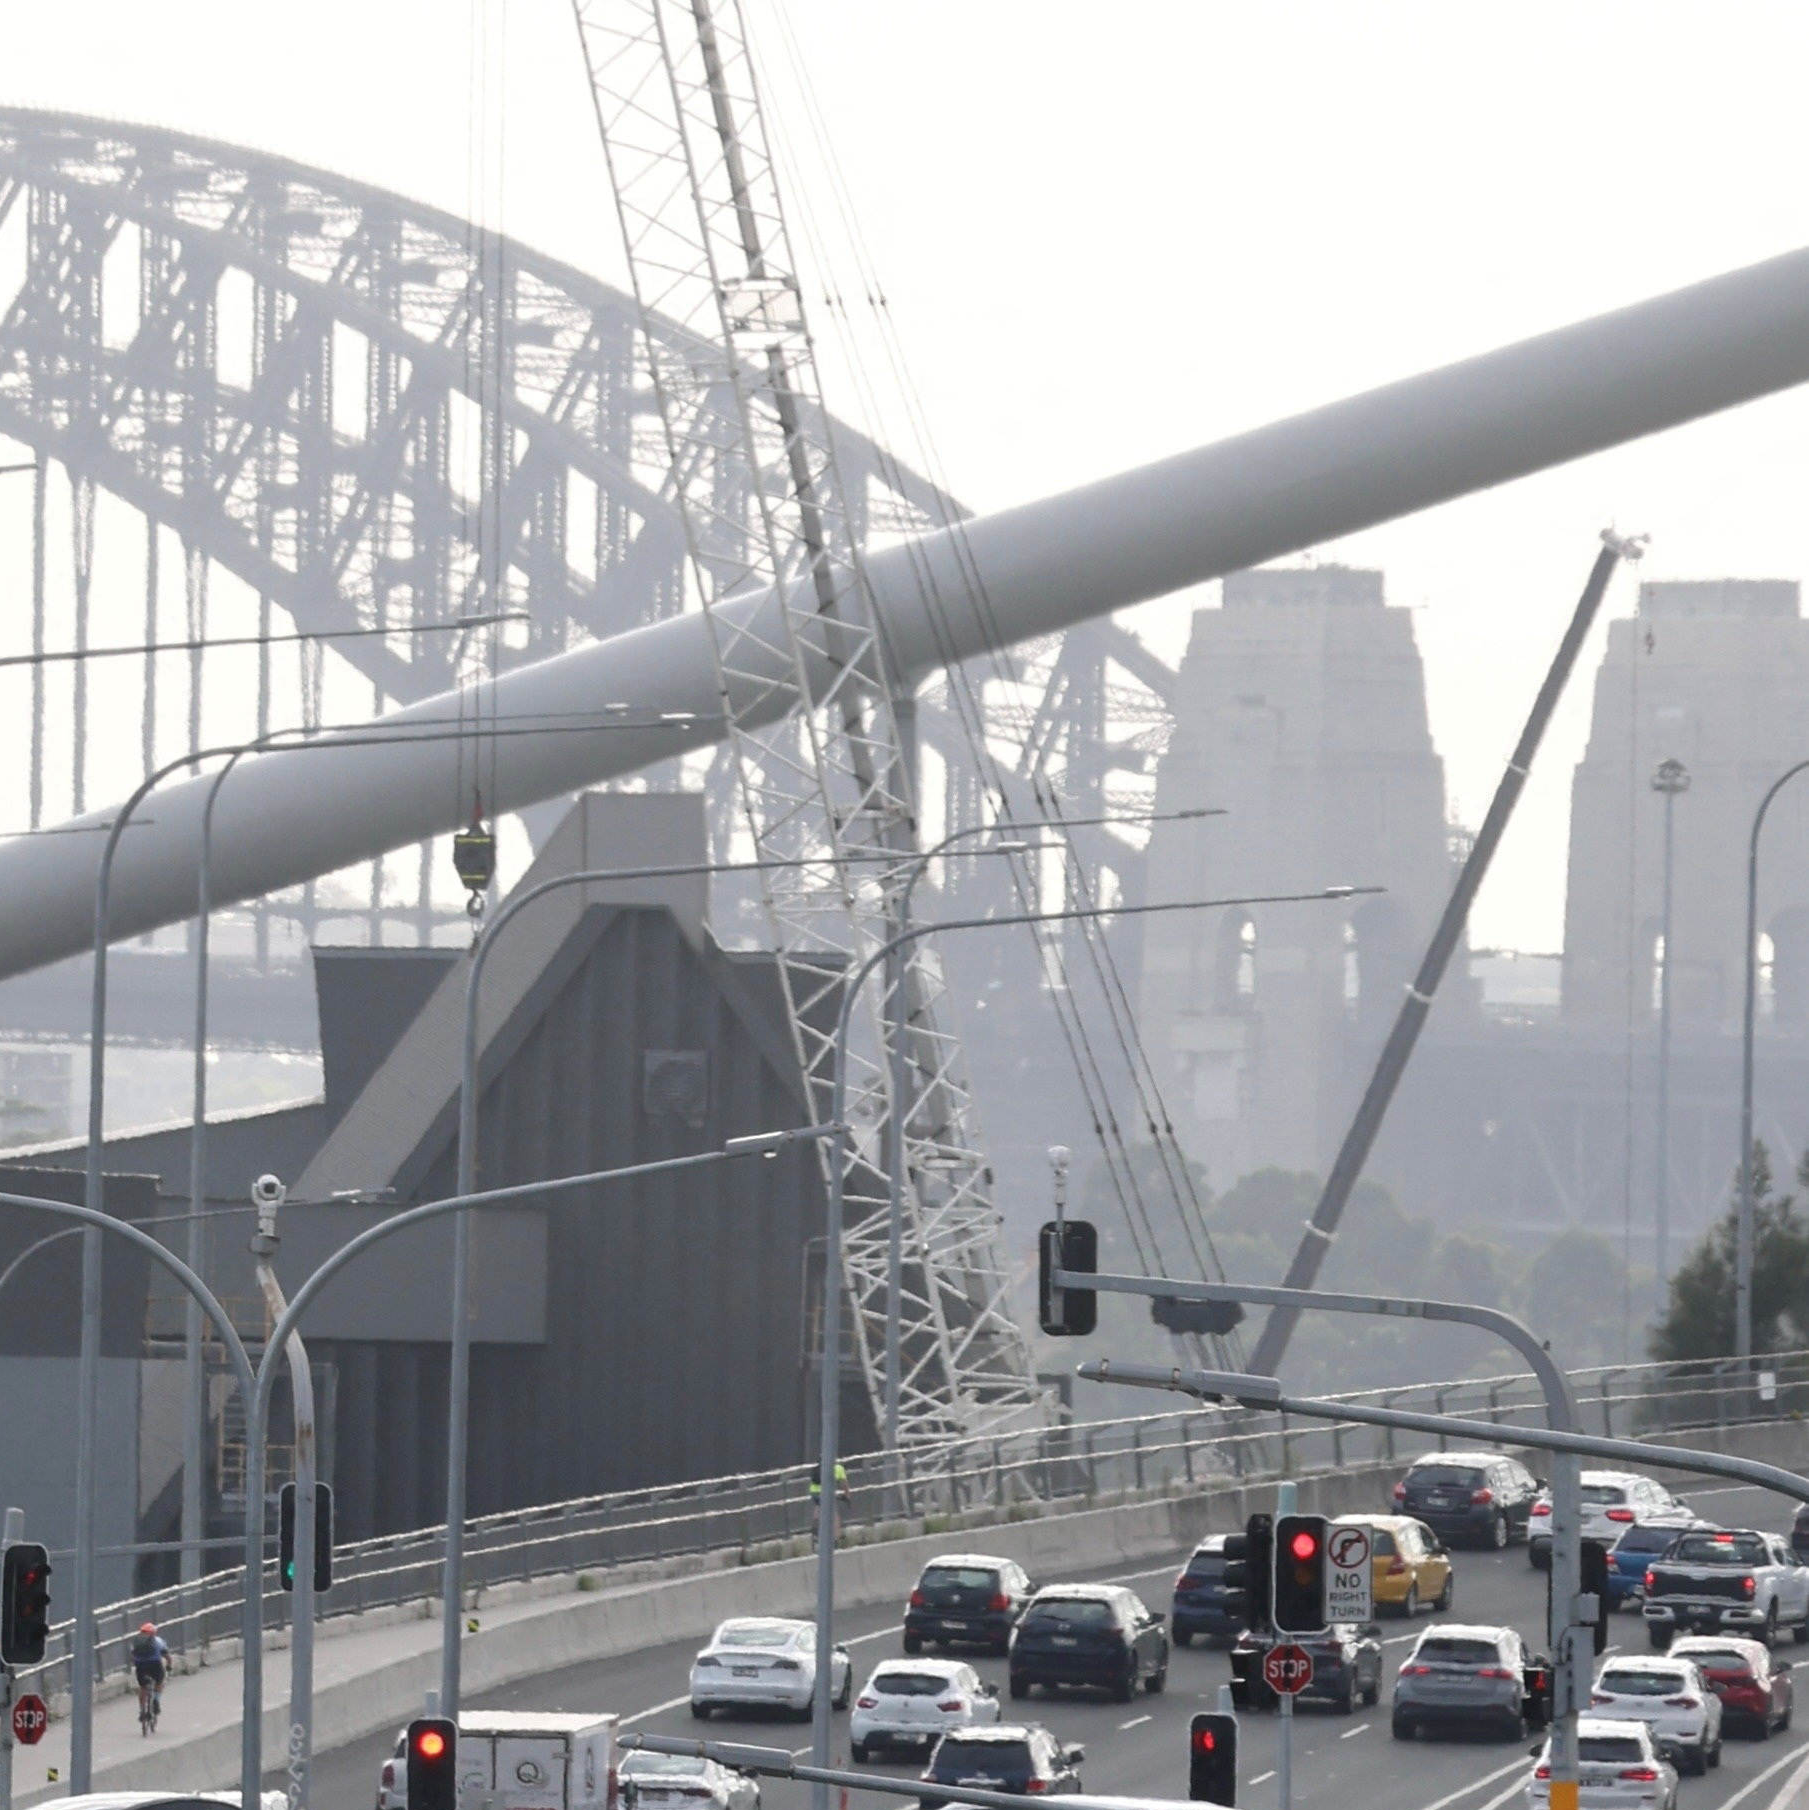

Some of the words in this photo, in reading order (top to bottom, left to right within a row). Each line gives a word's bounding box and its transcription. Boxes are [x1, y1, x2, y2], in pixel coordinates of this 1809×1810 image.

[1334, 1572, 1362, 1590] NO
[1329, 1591, 1368, 1602] RIGHT
[1331, 1606, 1367, 1618] TURN
[1268, 1659, 1309, 1678] STOP
[15, 1710, 44, 1725] STOP
